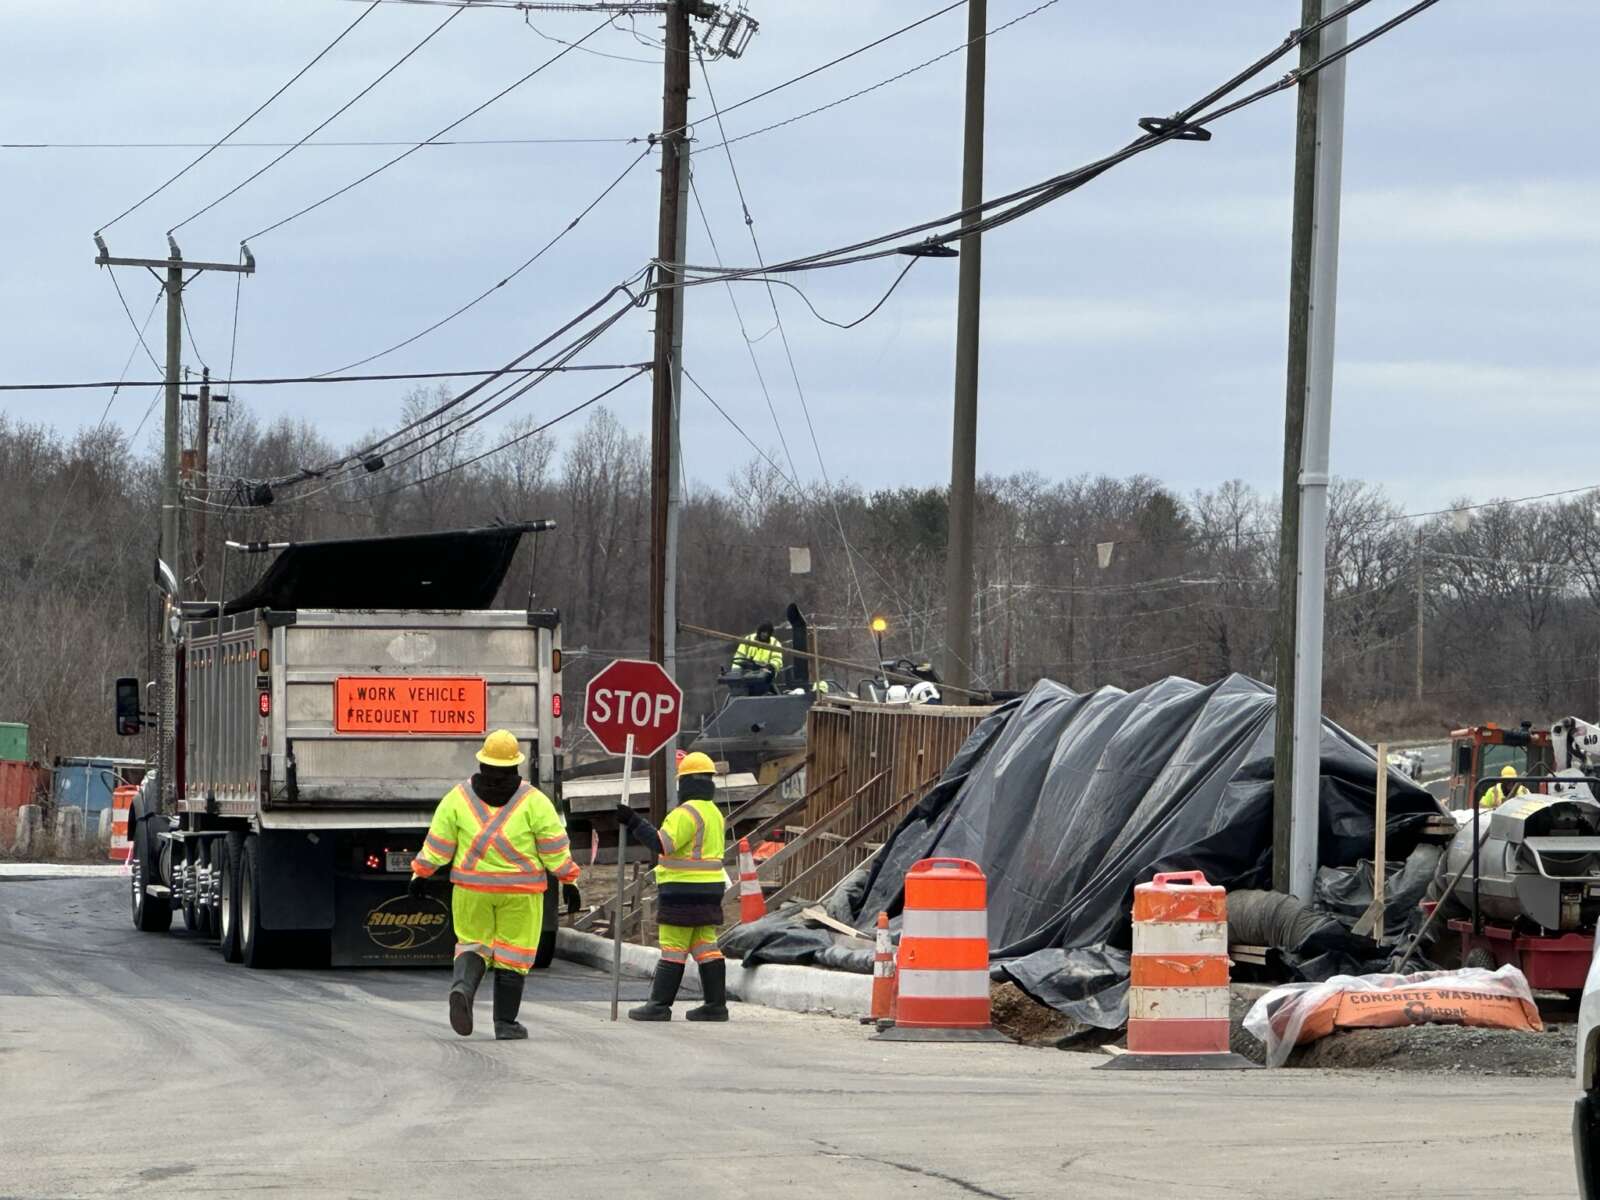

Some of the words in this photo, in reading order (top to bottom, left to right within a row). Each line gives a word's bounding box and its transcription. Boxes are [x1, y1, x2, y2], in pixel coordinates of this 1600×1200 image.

[357, 687, 396, 701] WORK
[409, 687, 466, 701] VEHICLE
[592, 688, 675, 728] STOP
[347, 708, 419, 724] FREQUENT
[430, 710, 475, 724] TURNS
[367, 911, 446, 926] Rhodes
[1350, 991, 1433, 1004] CONCRETE
